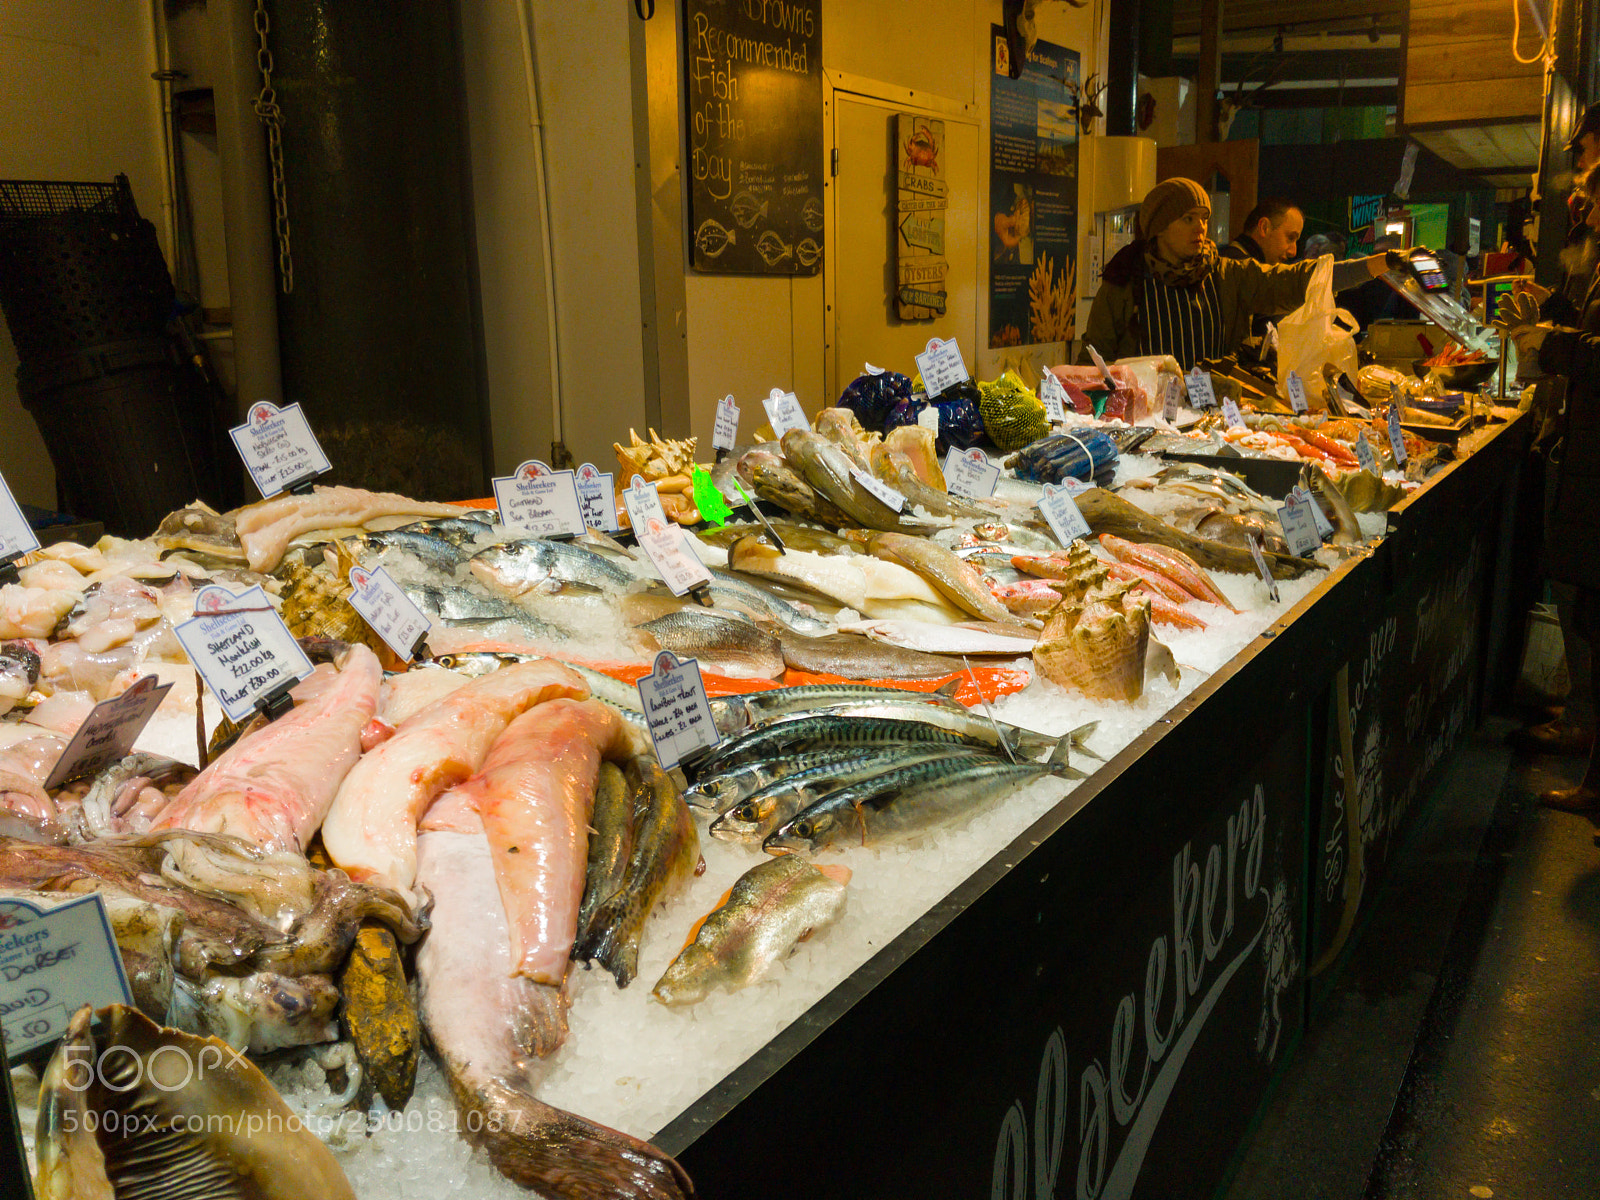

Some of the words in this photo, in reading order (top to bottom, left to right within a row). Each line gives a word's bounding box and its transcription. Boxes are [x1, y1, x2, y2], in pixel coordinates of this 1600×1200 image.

[693, 11, 809, 75] Recommended
[693, 56, 738, 101] Fish
[694, 101, 713, 149] of
[716, 103, 746, 140] the
[692, 147, 733, 200] Day
[904, 176, 934, 192] CRABS
[904, 265, 943, 281] OYSTERS
[516, 480, 557, 492] Shellseekers
[200, 612, 248, 636] Shellseeke
[0, 953, 22, 963] ame
